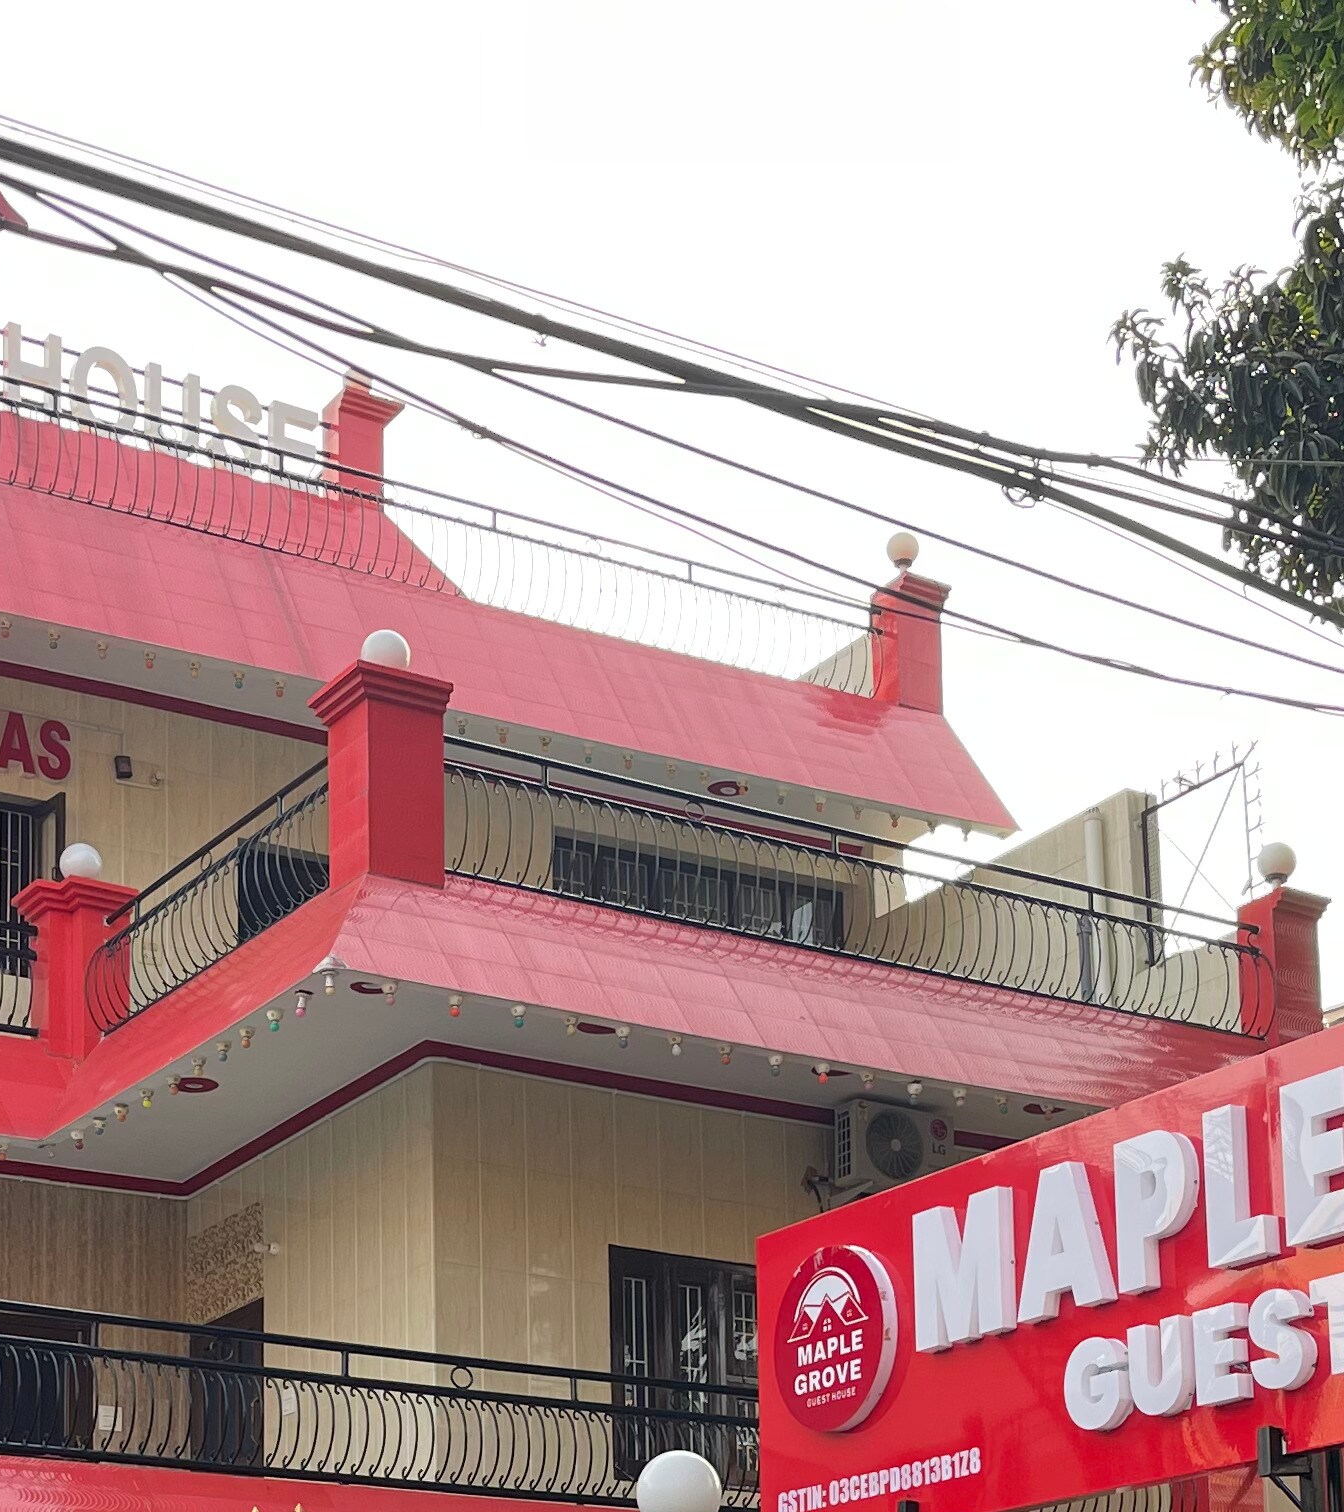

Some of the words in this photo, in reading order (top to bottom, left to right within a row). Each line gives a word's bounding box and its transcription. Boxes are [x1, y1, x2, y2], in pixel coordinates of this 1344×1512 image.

[3, 322, 320, 495] HOUSE
[932, 1143, 946, 1155] LG
[797, 1328, 864, 1367] MAPLE
[794, 1357, 862, 1396] GROVE
[806, 1392, 831, 1408] GUEST
[831, 1386, 856, 1401] HOUSE
